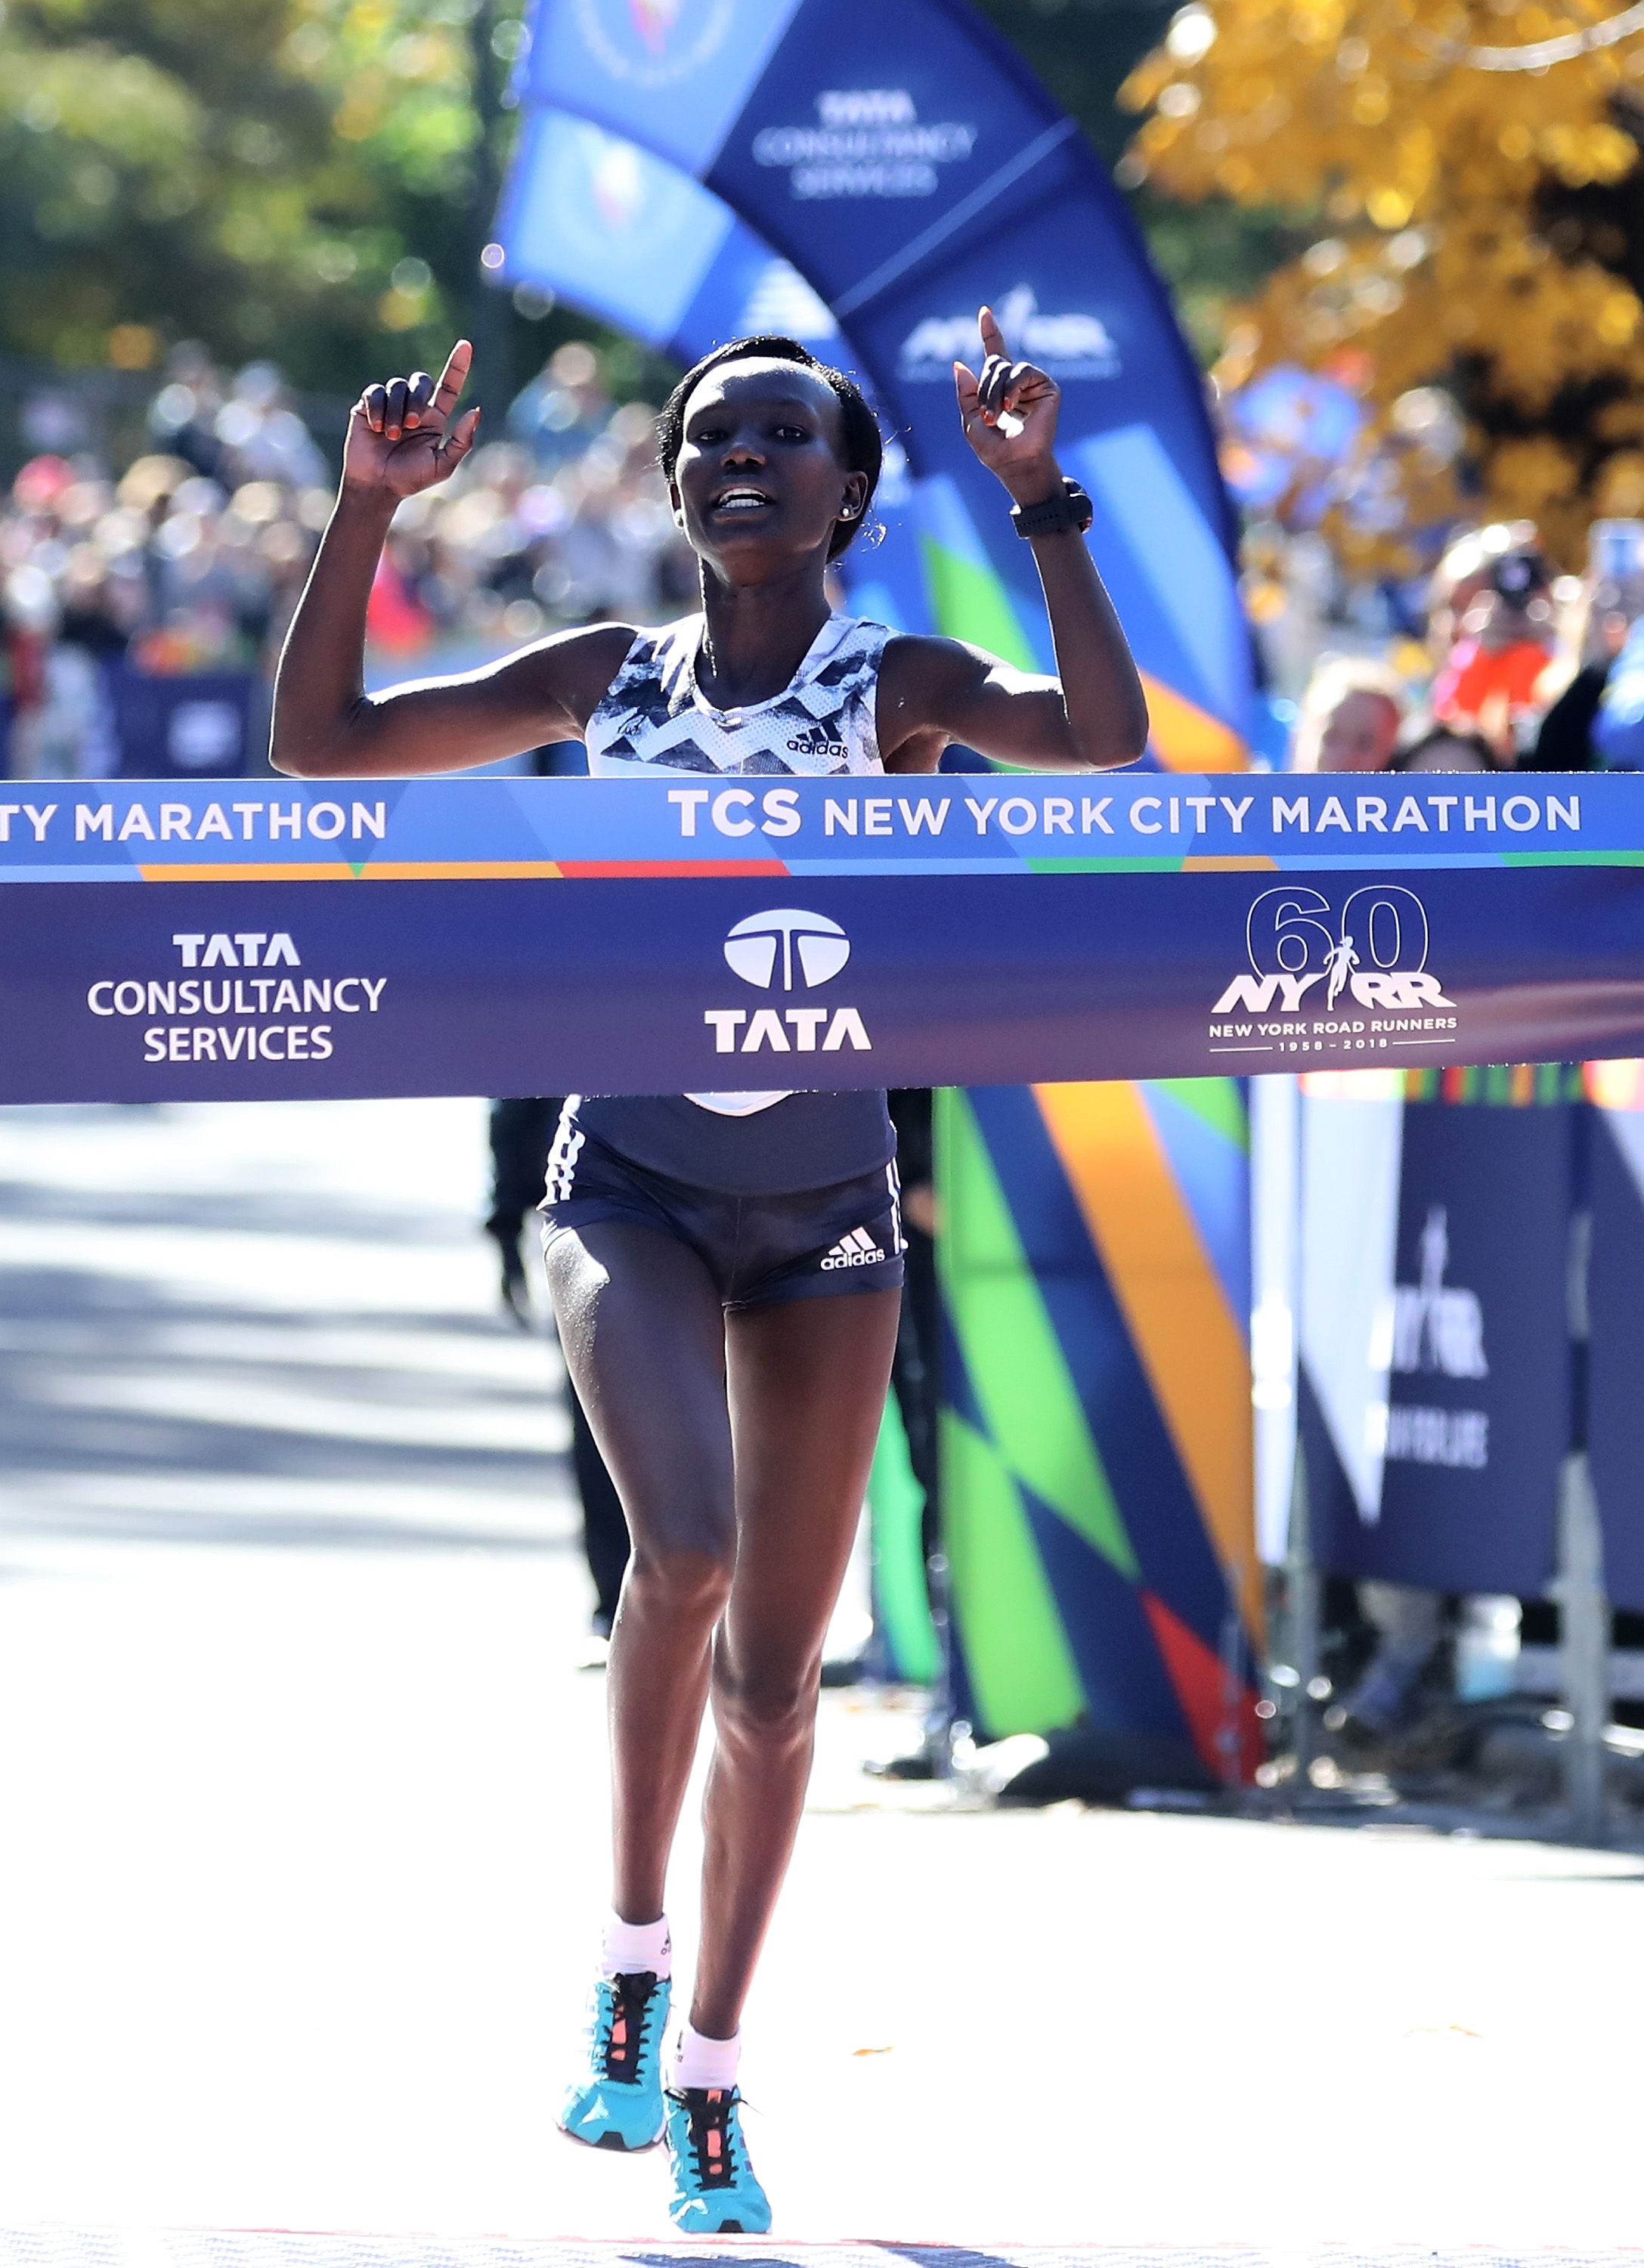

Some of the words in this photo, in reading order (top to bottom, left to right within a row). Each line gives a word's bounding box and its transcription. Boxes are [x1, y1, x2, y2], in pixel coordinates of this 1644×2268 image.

[787, 739, 849, 759] adidas
[75, 801, 386, 841] MARATHON
[667, 789, 801, 837] TCS
[825, 798, 951, 835] NEW
[964, 797, 1115, 835] YORK
[1129, 796, 1255, 834] CITY
[1272, 795, 1580, 833] MARATHON
[172, 933, 301, 968] TATA
[87, 978, 387, 1016] CONSULTANCY
[144, 1025, 333, 1062] SERVICES
[704, 1008, 872, 1053] TATA
[1209, 1024, 1253, 1037] NEW
[1256, 1022, 1308, 1036] YORK
[1312, 1021, 1366, 1034] ROAD
[1370, 1017, 1458, 1033] RUNNERS
[820, 1248, 886, 1271] adidas
